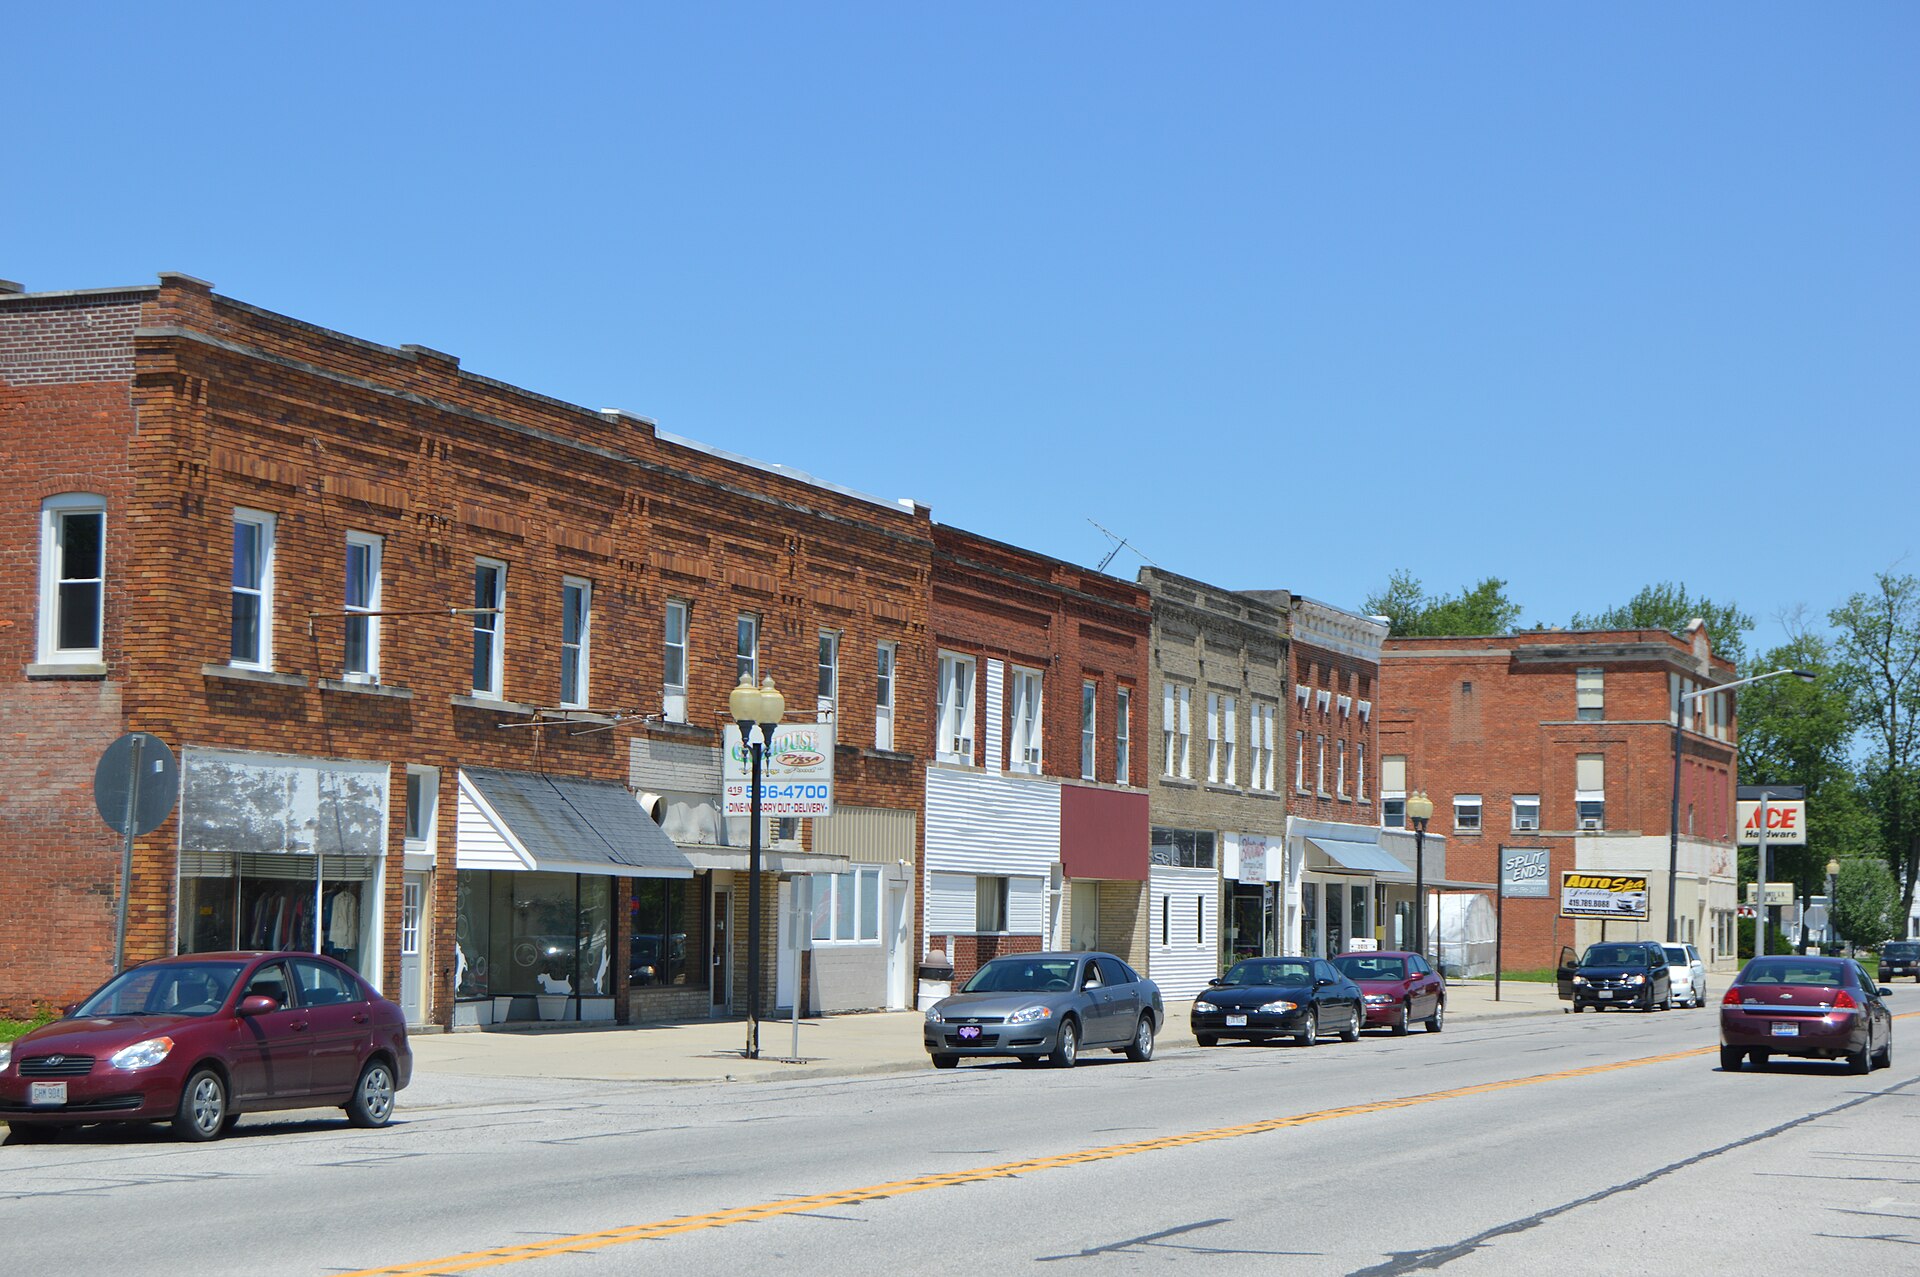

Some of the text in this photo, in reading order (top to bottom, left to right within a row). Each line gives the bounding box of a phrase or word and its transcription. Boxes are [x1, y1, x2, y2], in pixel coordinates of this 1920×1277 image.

[728, 785, 828, 799] 419 596-4700
[729, 803, 825, 813] DINE-IN ARRY OUT DELIVERY
[1745, 806, 1798, 828] ACE
[1745, 829, 1798, 838] Hadware
[1505, 851, 1546, 871] SPLIT
[1513, 863, 1547, 882] ENDS
[1568, 889, 1614, 898] Detailing
